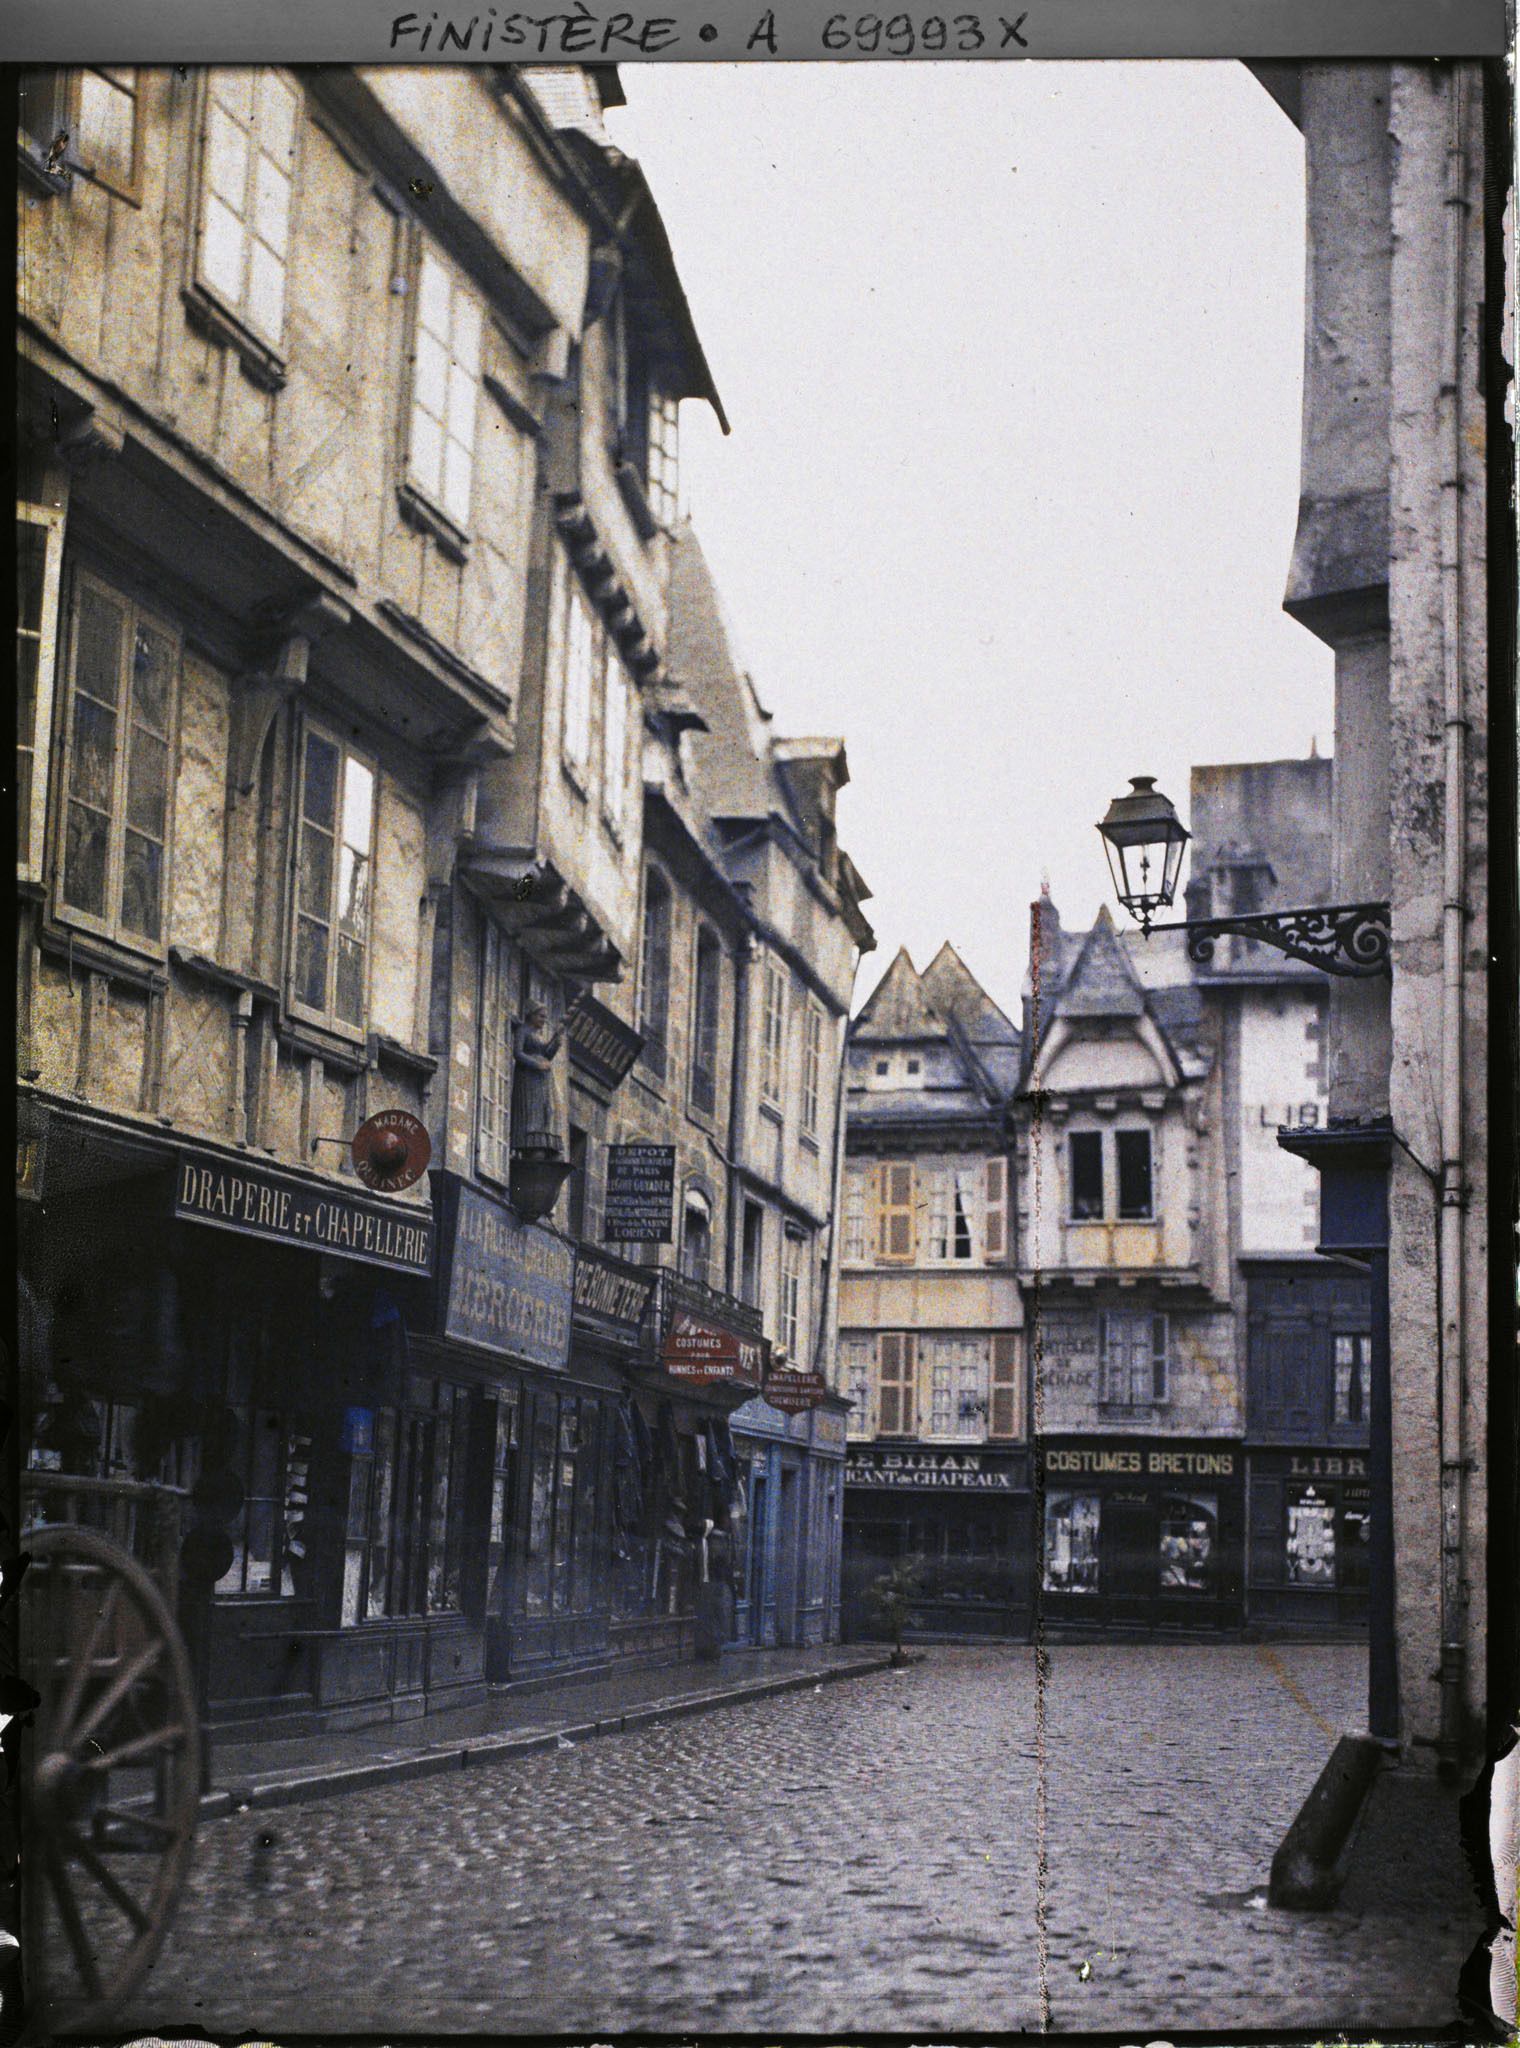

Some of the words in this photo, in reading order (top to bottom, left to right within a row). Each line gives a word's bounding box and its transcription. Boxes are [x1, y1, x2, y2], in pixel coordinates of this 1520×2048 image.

[747, 14, 779, 53] A
[374, 1114, 419, 1135] MADAME
[633, 1166, 661, 1176] PARIS
[182, 1165, 293, 1231] DRAPERIE
[295, 1212, 311, 1235] ET
[315, 1202, 429, 1265] CHAPELLERIE
[614, 1228, 662, 1239] LORIENT
[587, 1262, 651, 1324] BONNETERIE
[675, 1337, 722, 1349] COSTUMES
[703, 1364, 735, 1377] ENFANTS
[881, 1454, 982, 1471] BIHAN
[1045, 1450, 1142, 1473] COSTUMES
[1148, 1451, 1235, 1475] BRETONS
[1290, 1456, 1367, 1476] LIBR
[897, 1473, 913, 1485] de
[913, 1471, 1011, 1488] CHAPEAUX
